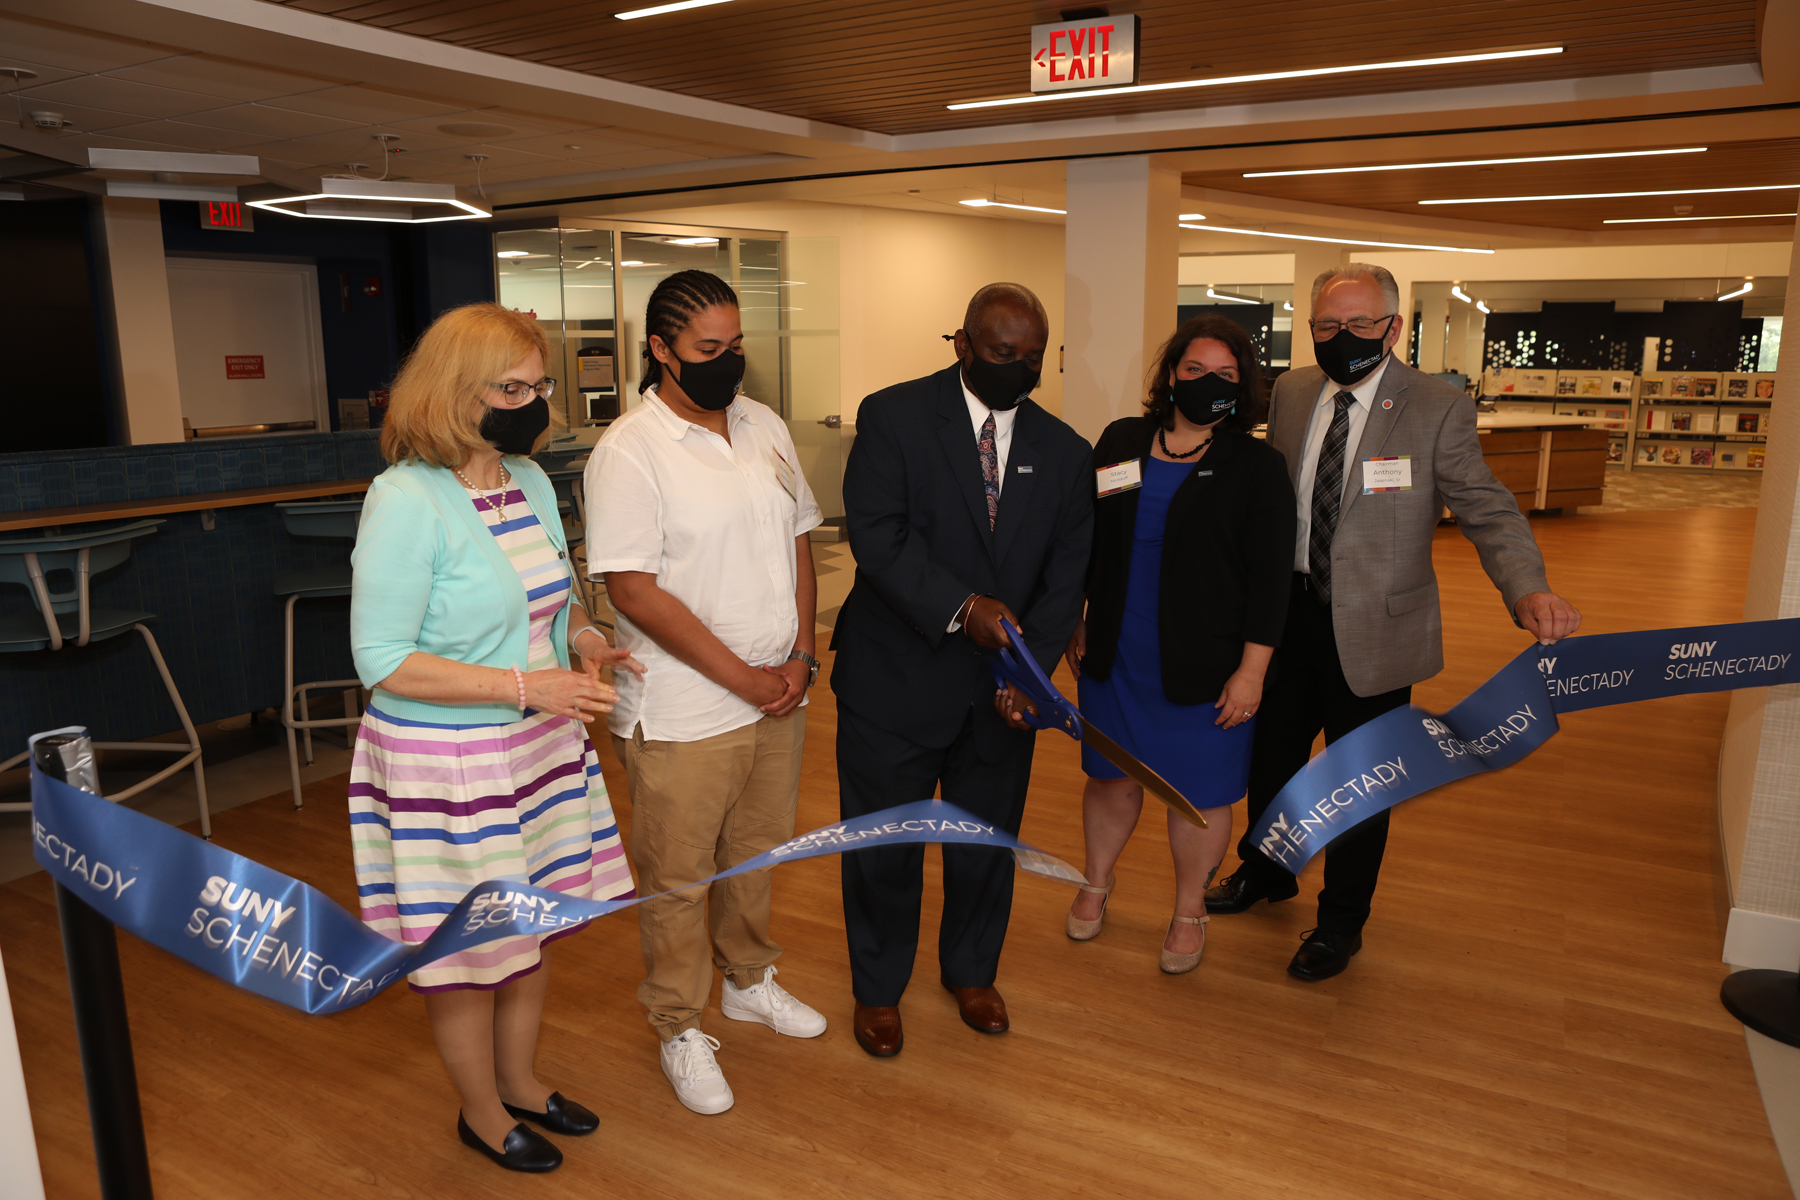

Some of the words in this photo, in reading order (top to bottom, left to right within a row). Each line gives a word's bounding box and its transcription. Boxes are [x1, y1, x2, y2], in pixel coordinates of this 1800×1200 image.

[1050, 24, 1115, 82] EXIT
[209, 201, 242, 227] EXIT
[1349, 357, 1362, 366] SUNY
[1111, 470, 1128, 478] Stacy
[1669, 641, 1717, 659] SUNY
[1664, 653, 1792, 681] SCHENECTADY
[1544, 669, 1635, 697] ENECTADY
[1274, 756, 1407, 865] HENECTADY
[769, 824, 848, 855] SUNY
[773, 819, 995, 857] SCHENECTADY
[199, 875, 296, 932] SUNY
[470, 891, 559, 914] SUNY
[187, 907, 401, 1002] SCHENECTAD
